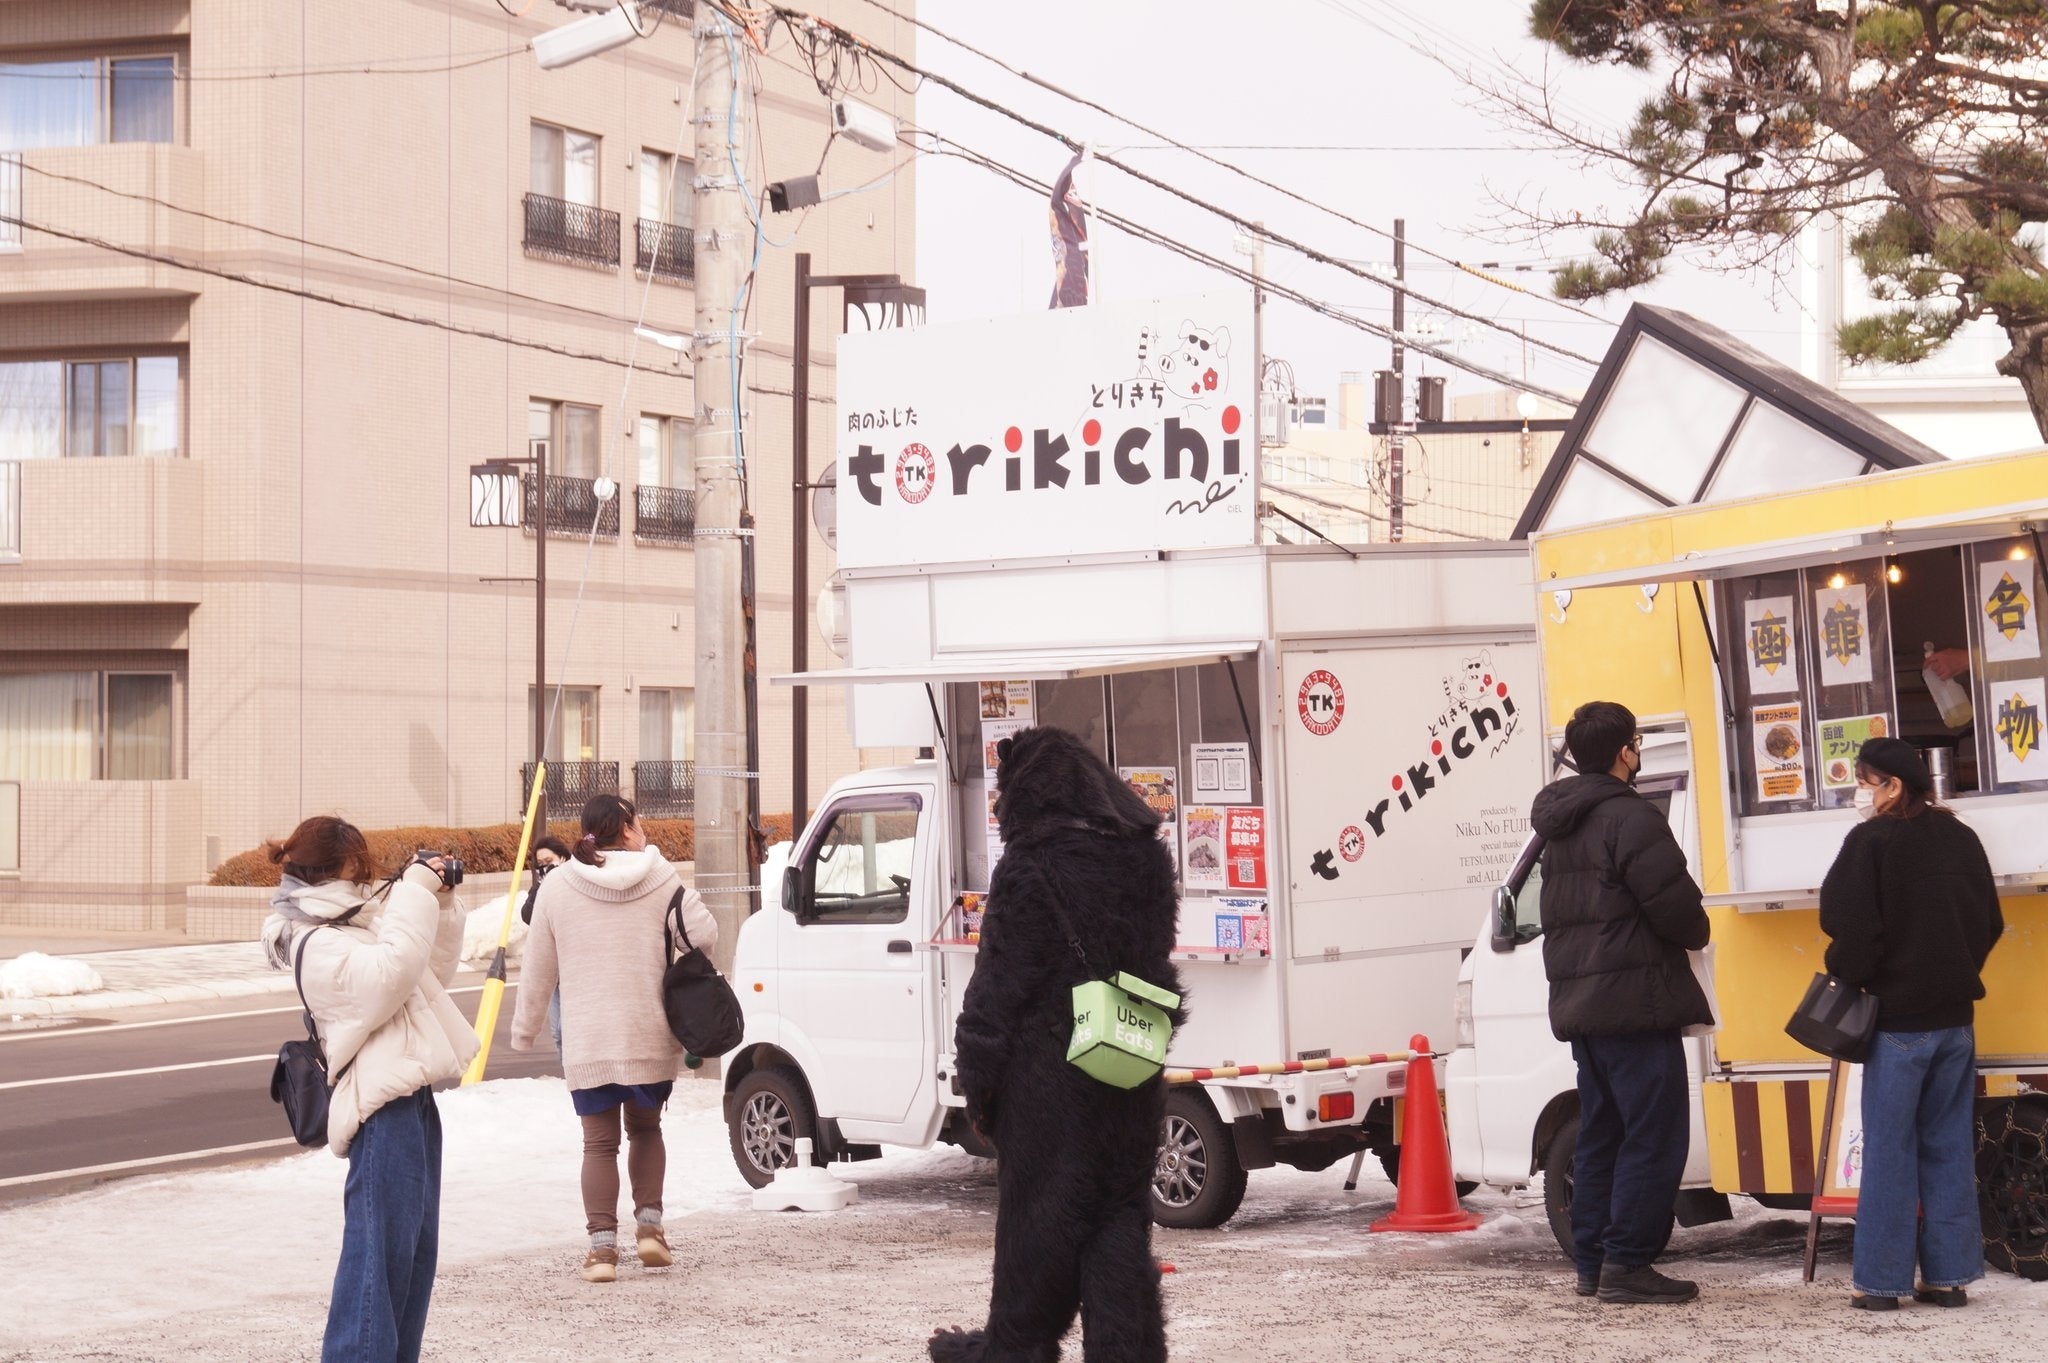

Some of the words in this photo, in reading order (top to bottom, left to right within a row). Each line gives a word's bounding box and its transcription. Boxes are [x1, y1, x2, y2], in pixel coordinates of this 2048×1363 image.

[1091, 382, 1165, 409] とりきち
[847, 406, 918, 432] 肉のふじた
[904, 465, 926, 482] TK
[1988, 577, 2026, 634] 名
[1750, 615, 1787, 669] 函
[1822, 603, 1861, 659] 館
[1308, 694, 1335, 712] TK
[1427, 699, 1470, 738] とりきち
[1998, 699, 2041, 752] 物
[1231, 815, 1261, 830] 友だち
[1480, 806, 1508, 818] produced
[1509, 805, 1518, 816] by
[1455, 822, 1481, 838] Niku
[1484, 820, 1500, 836] No
[1480, 841, 1501, 853] special
[1502, 839, 1522, 849] thanks
[1466, 872, 1481, 884] and
[1483, 869, 1503, 882] ALL
[1117, 1005, 1154, 1033] Uber
[1114, 1023, 1154, 1052] Eats
